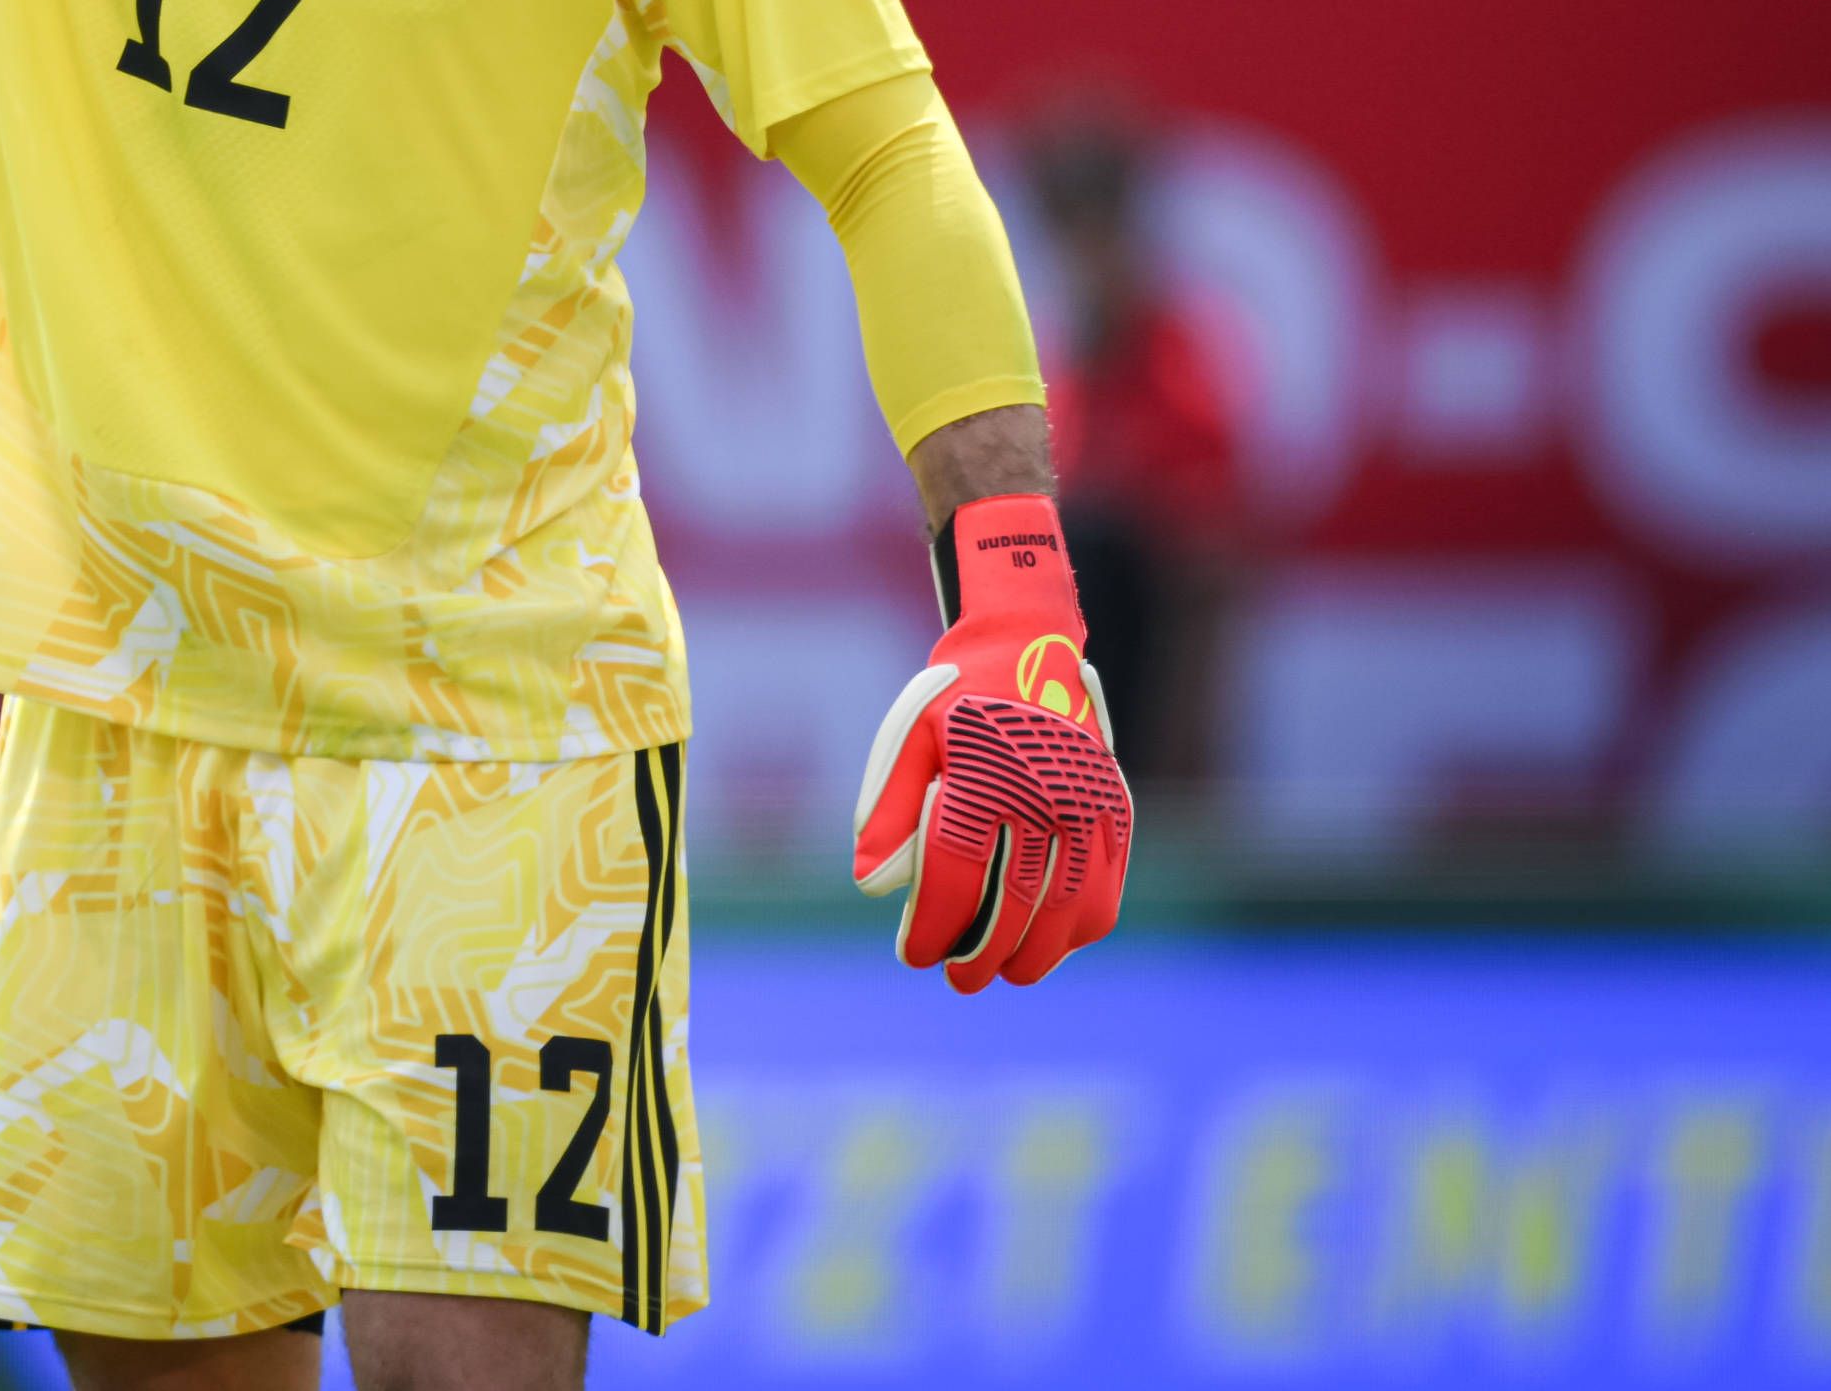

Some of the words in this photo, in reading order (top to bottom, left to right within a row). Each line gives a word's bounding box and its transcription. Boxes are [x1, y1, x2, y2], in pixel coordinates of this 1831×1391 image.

[977, 534, 1058, 551] Baumann
[1011, 551, 1036, 568] Oli
[432, 1034, 613, 1242] 12
